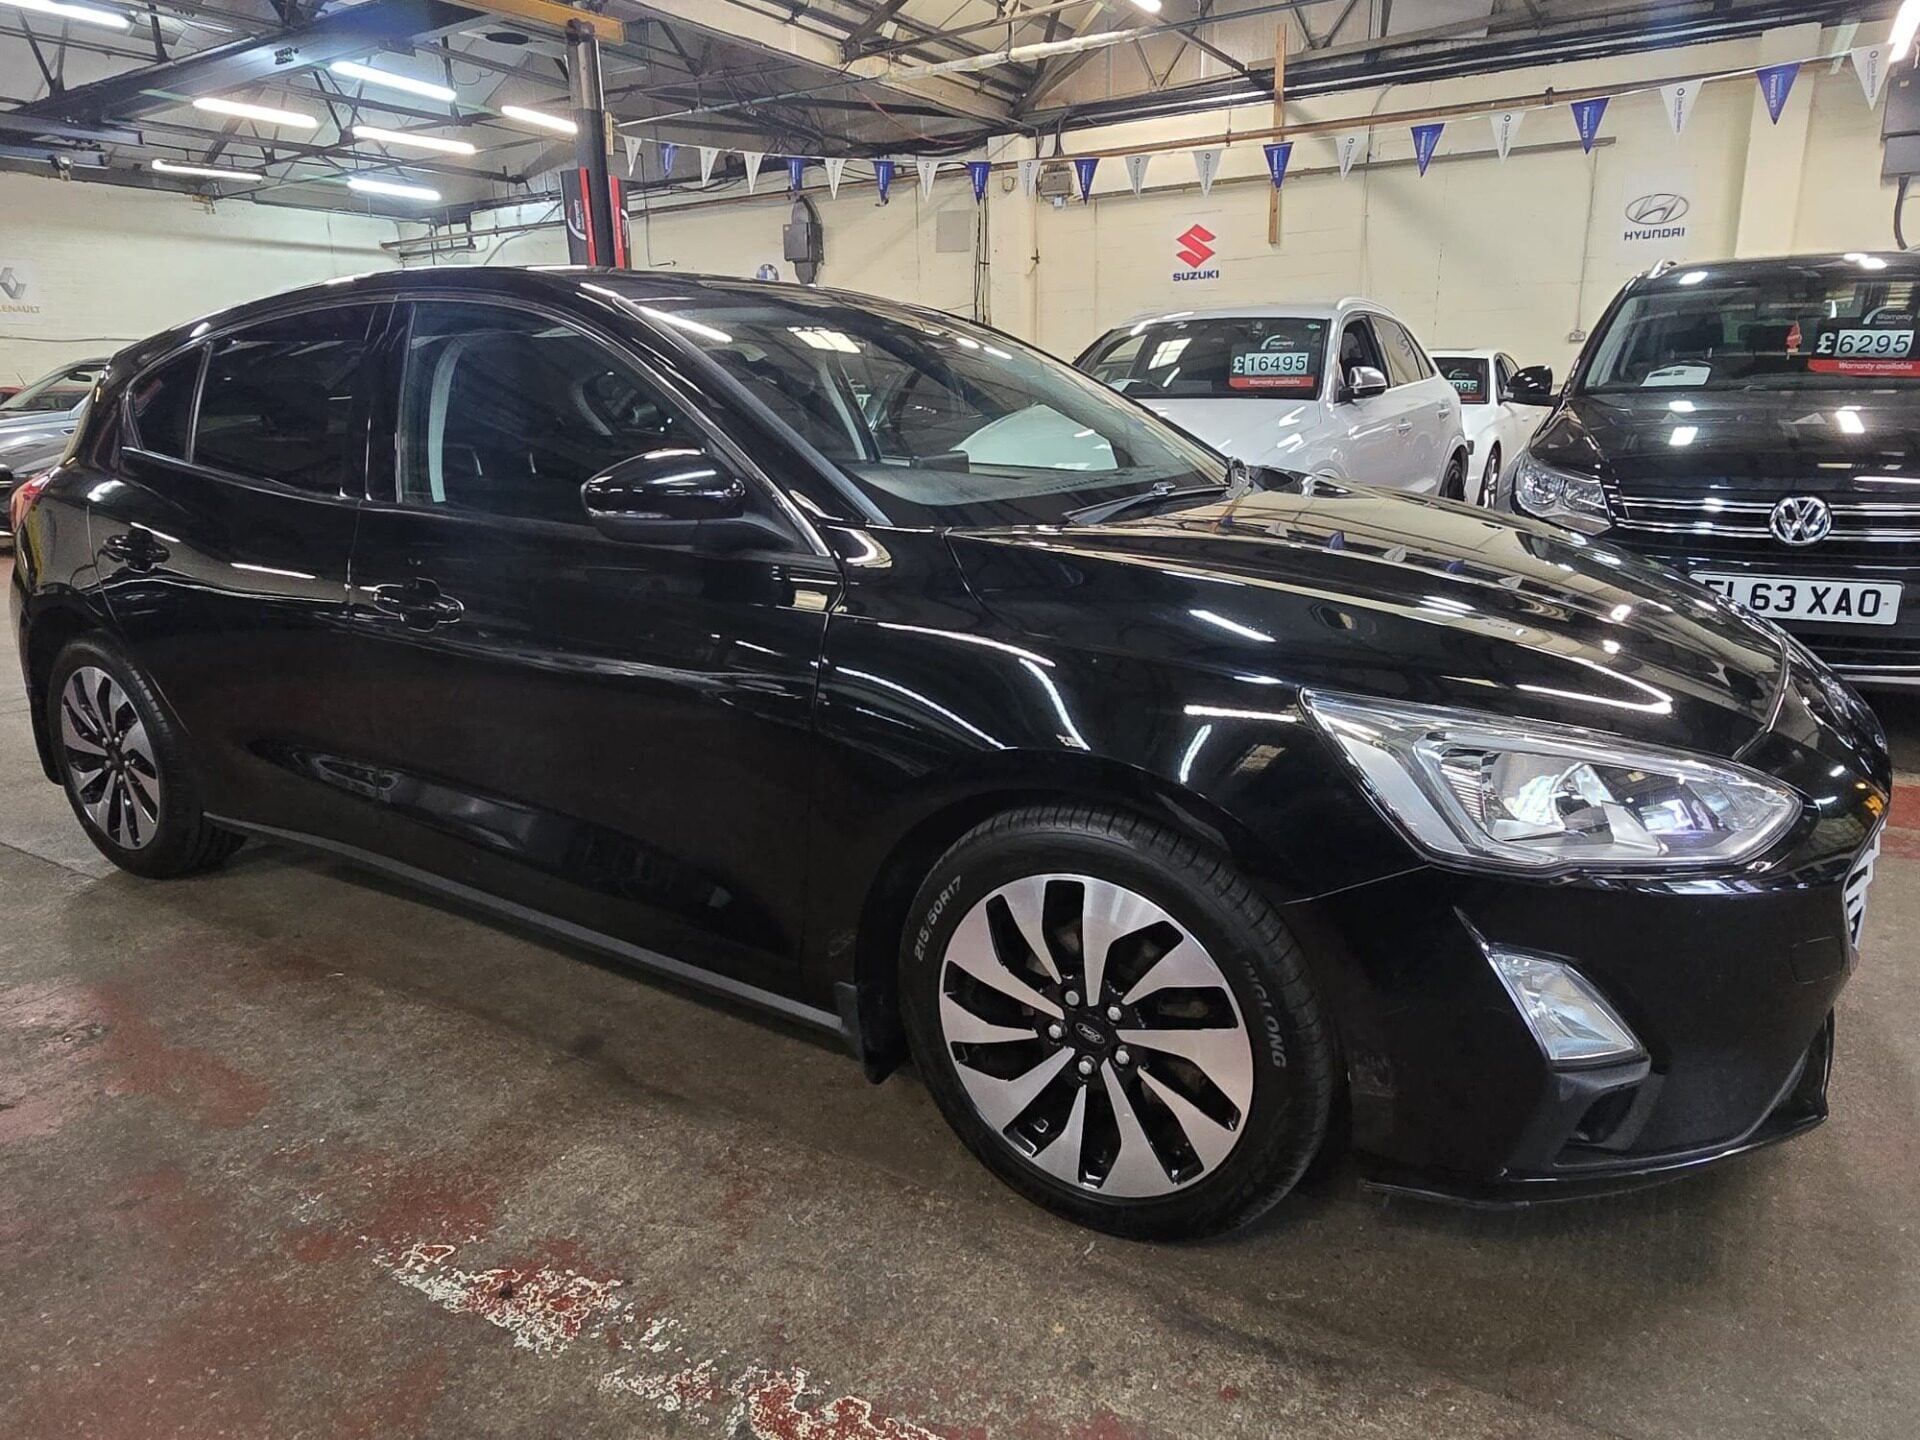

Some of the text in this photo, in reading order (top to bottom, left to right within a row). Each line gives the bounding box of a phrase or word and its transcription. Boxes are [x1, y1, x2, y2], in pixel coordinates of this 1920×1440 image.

[1623, 227, 1686, 241] HYUNDAI
[1173, 269, 1220, 281] SUZUKI
[0, 304, 40, 314] ENAULT
[1816, 332, 1911, 354] £6295
[1232, 355, 1306, 374] £16495
[1839, 360, 1913, 371] Warranty available
[914, 875, 961, 961] 215/50R17
